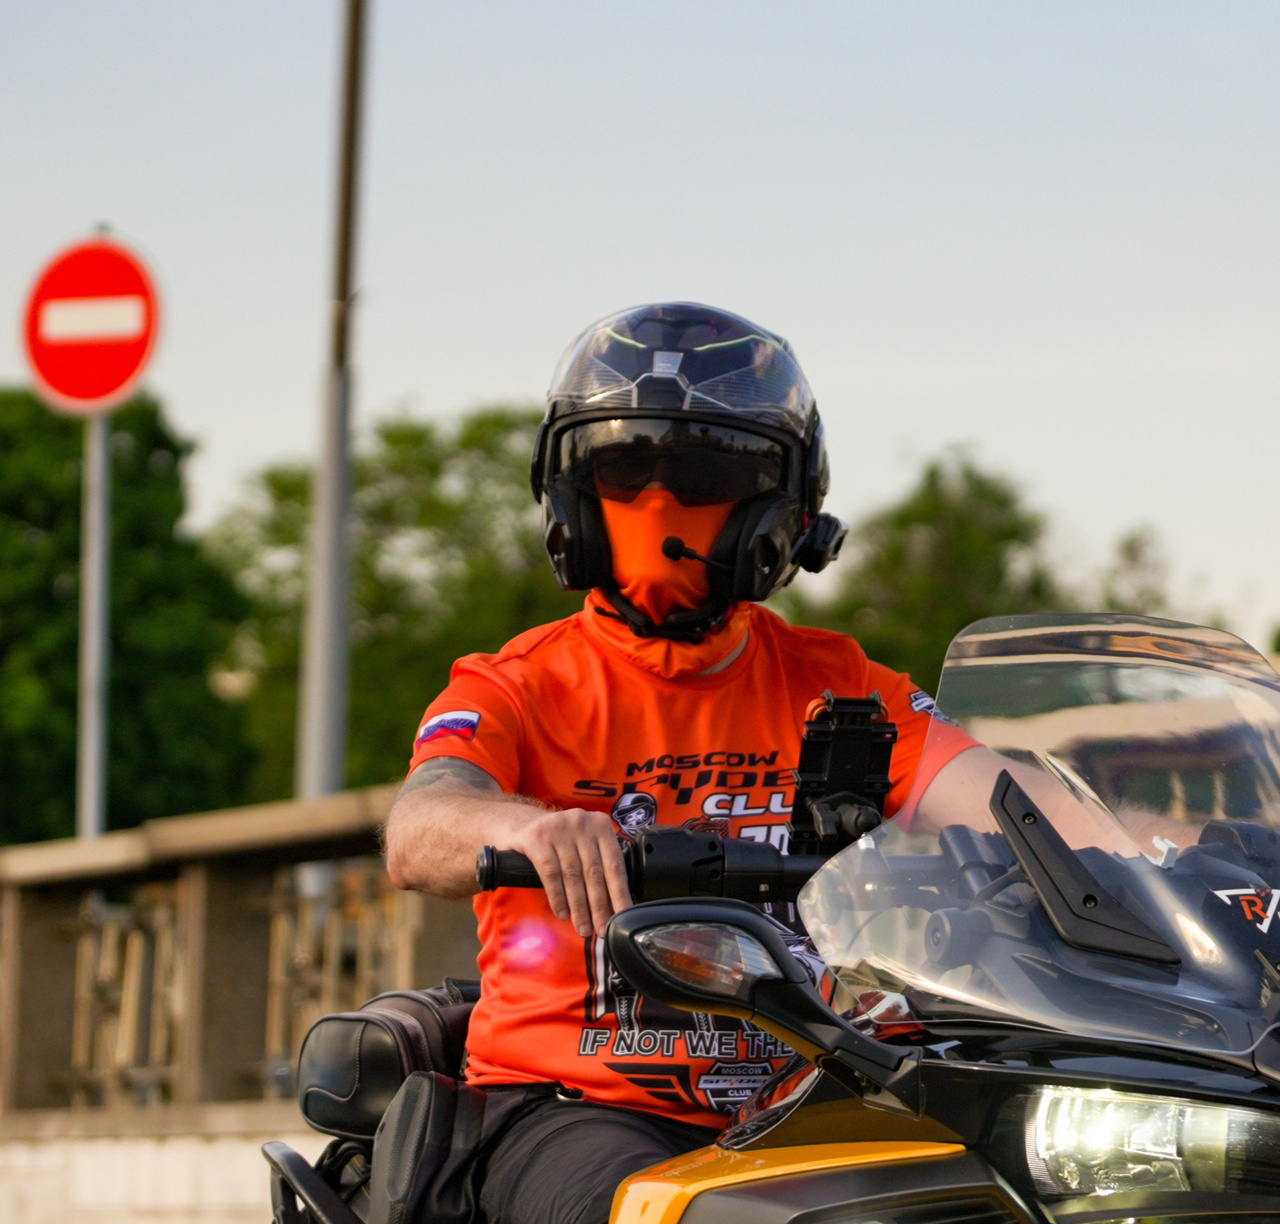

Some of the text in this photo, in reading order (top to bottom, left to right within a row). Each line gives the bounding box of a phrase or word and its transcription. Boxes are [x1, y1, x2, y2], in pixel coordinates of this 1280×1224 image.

[626, 751, 779, 777] MOSCOW
[573, 768, 798, 805] SPYDE
[702, 792, 794, 817] CLU
[578, 1029, 611, 1056] IF
[613, 1029, 680, 1057] NOT
[686, 1030, 738, 1059] WE
[721, 1067, 763, 1075] MOSCOW
